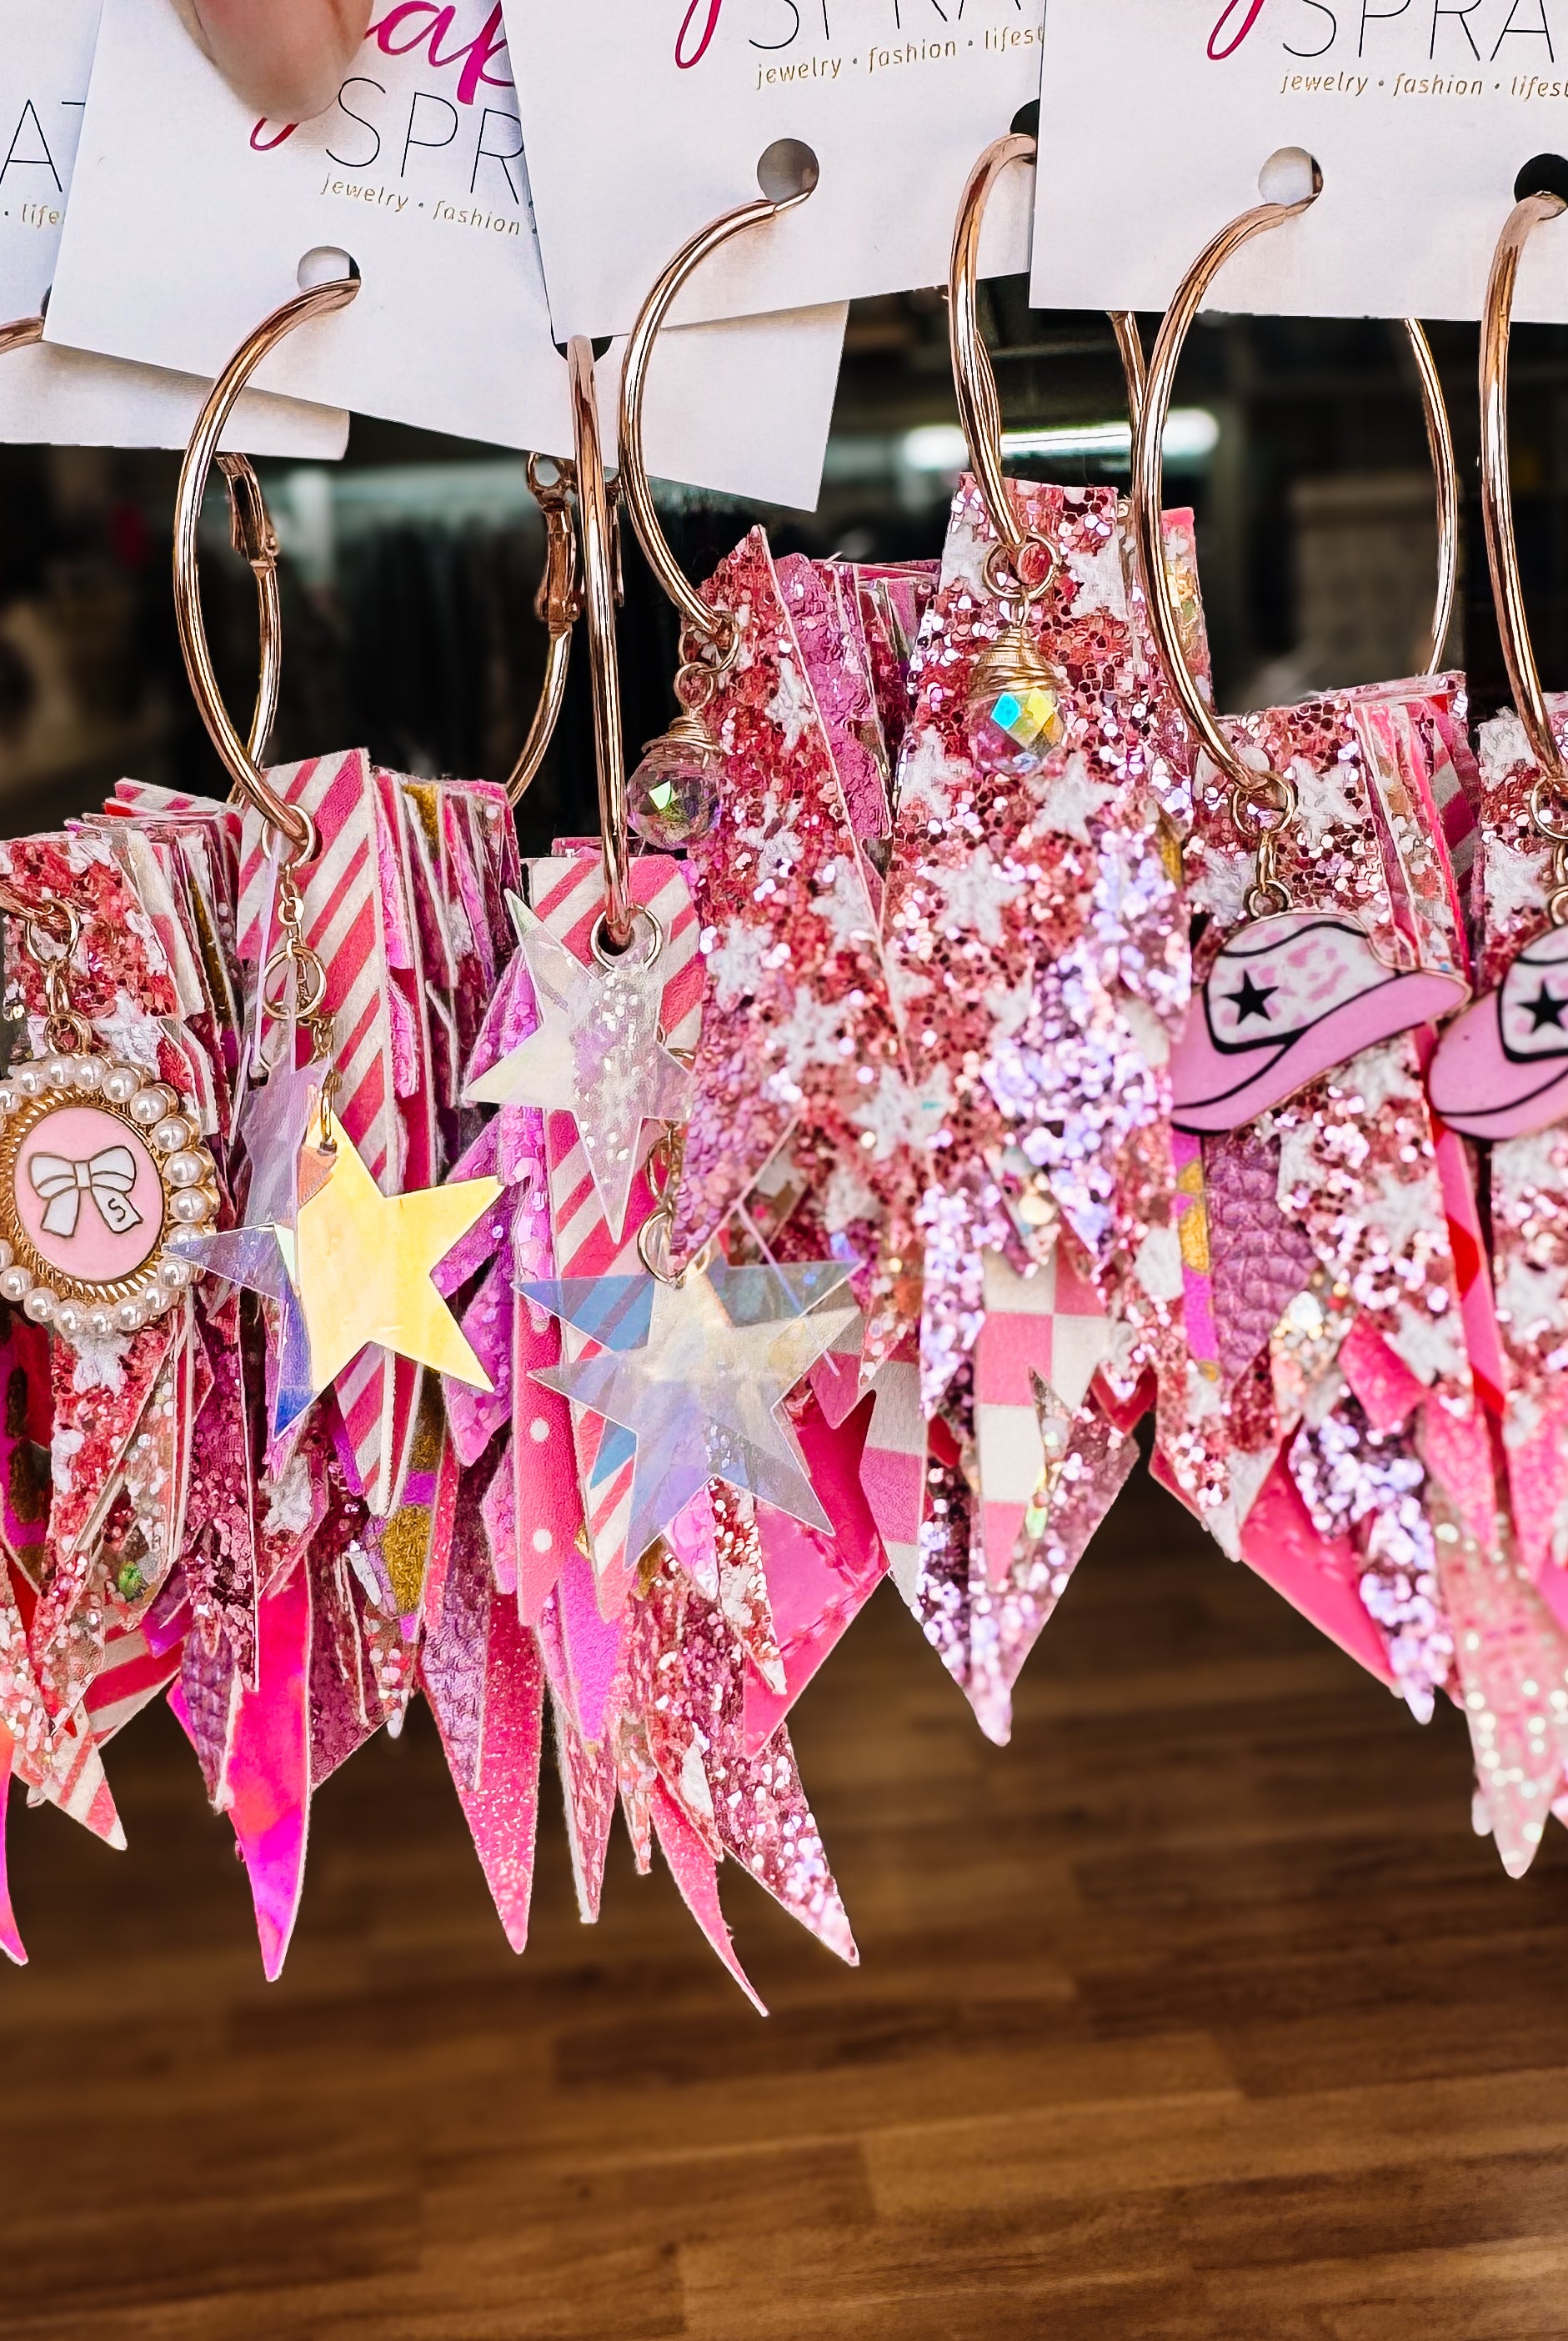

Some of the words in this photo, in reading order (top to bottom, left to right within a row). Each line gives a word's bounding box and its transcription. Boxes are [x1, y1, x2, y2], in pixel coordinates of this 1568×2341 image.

[757, 57, 842, 91] jewelry
[869, 40, 957, 73] fashion
[1280, 68, 1369, 97] jewelry
[1393, 73, 1483, 97] fashion
[325, 77, 524, 205] SPR
[319, 173, 409, 213] jewelry
[432, 199, 520, 235] fashion
